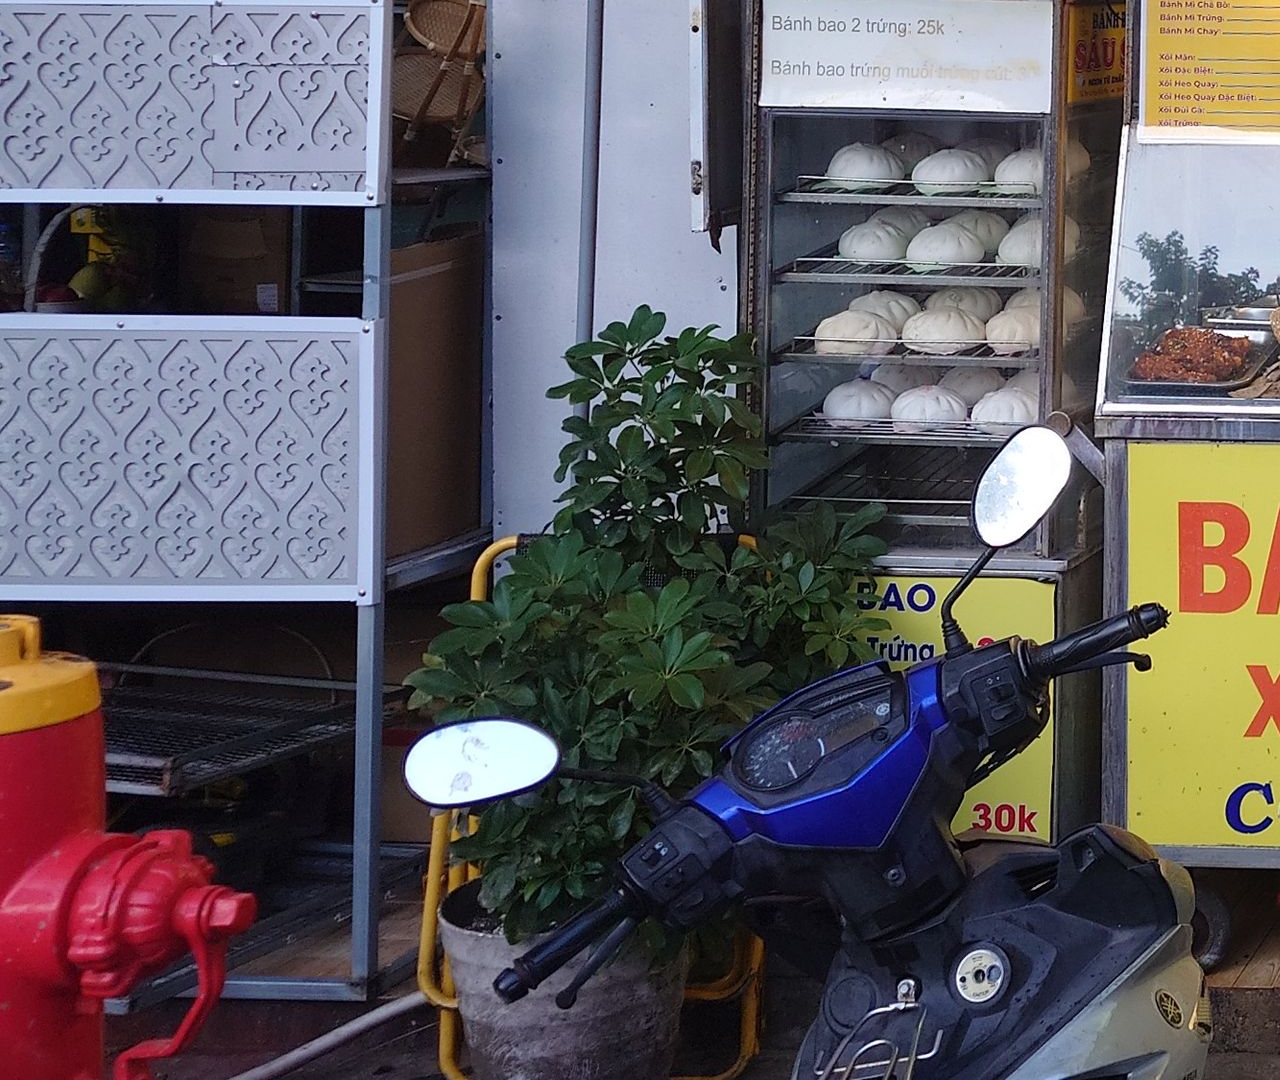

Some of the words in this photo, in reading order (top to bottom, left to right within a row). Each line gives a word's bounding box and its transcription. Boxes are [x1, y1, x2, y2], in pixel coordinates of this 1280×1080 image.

[772, 15, 812, 32] Bánh
[818, 17, 846, 32] bao
[851, 17, 861, 32] 2
[866, 17, 912, 37] trứng:
[916, 20, 945, 35] 25k
[771, 60, 811, 76] Bánh
[816, 62, 845, 77] bao
[850, 62, 891, 82] trứng
[971, 803, 1037, 833] 30k
